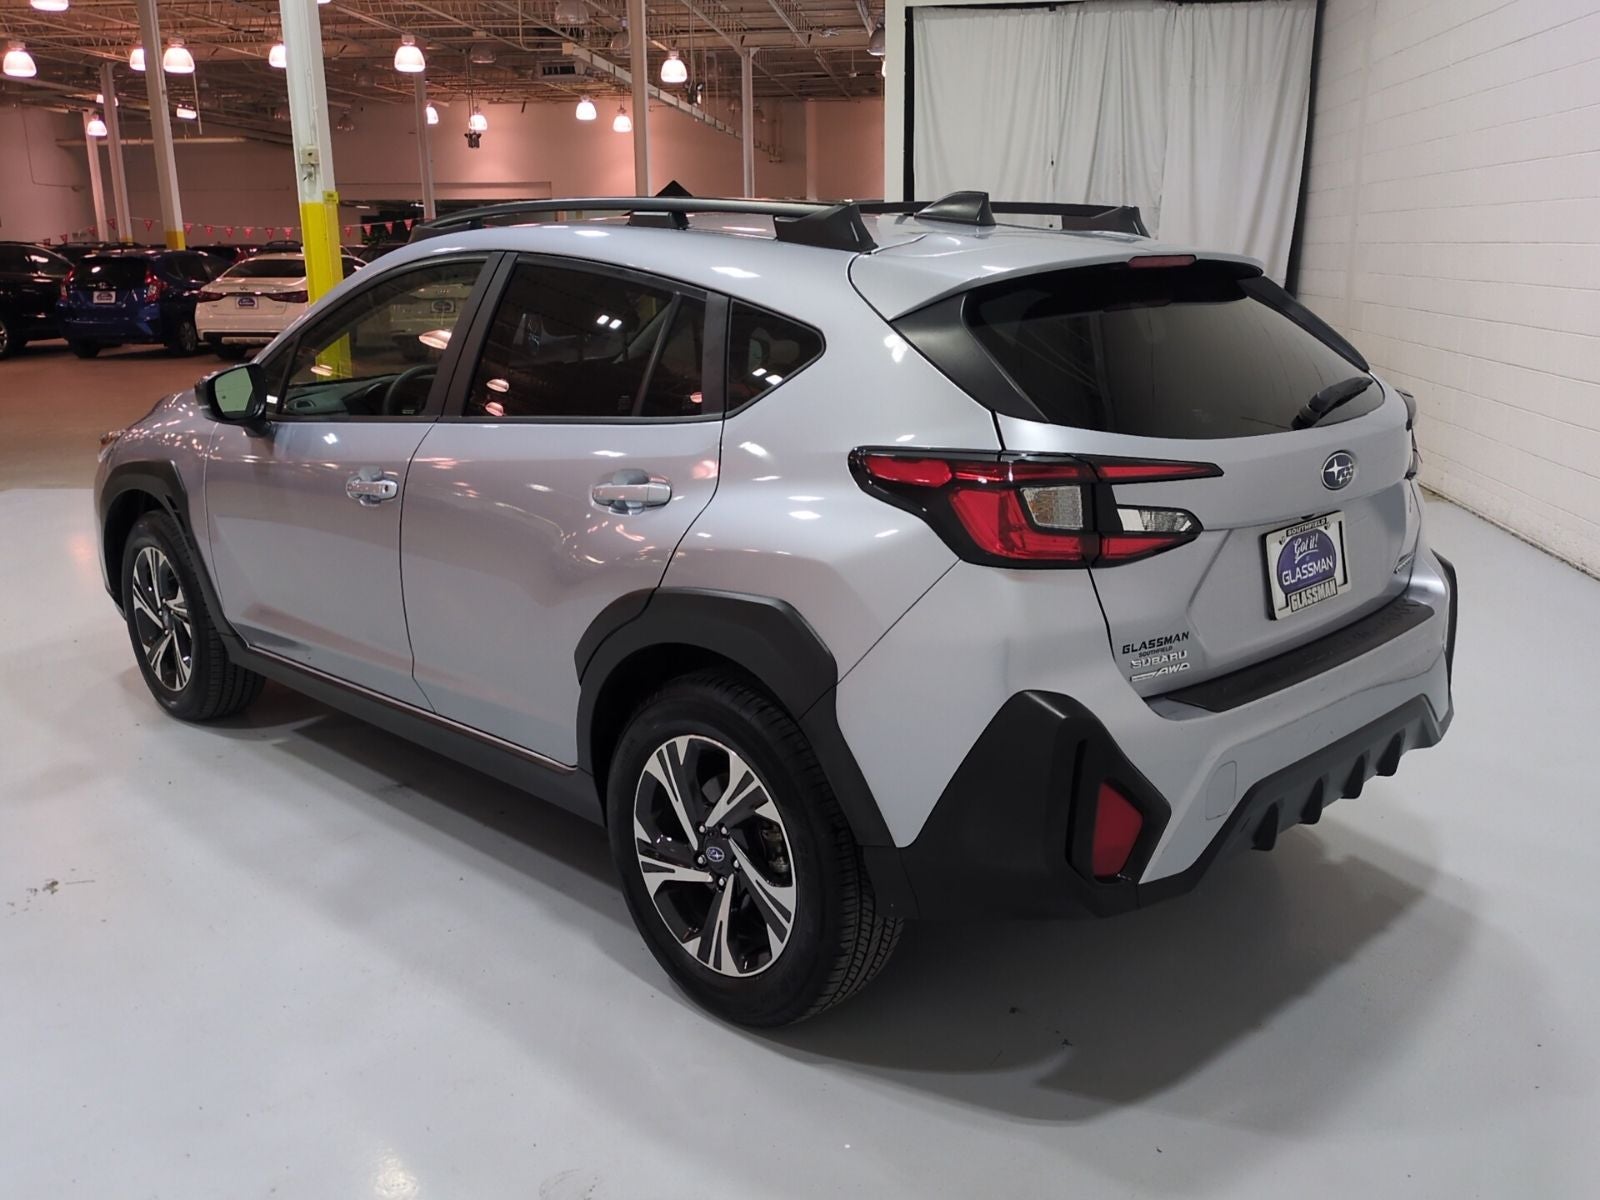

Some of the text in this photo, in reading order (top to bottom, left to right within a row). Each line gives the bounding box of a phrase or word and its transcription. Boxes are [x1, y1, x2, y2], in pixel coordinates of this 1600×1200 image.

[1286, 518, 1327, 537] SOUTHFIELD
[1294, 537, 1309, 556] Got
[1282, 556, 1334, 586] GLASSMAN
[1291, 580, 1337, 610] GLASSMAN
[1122, 631, 1190, 655] GLASSMAN
[1138, 645, 1173, 658] SOUTHFIELD
[1131, 650, 1187, 669] SUBARU
